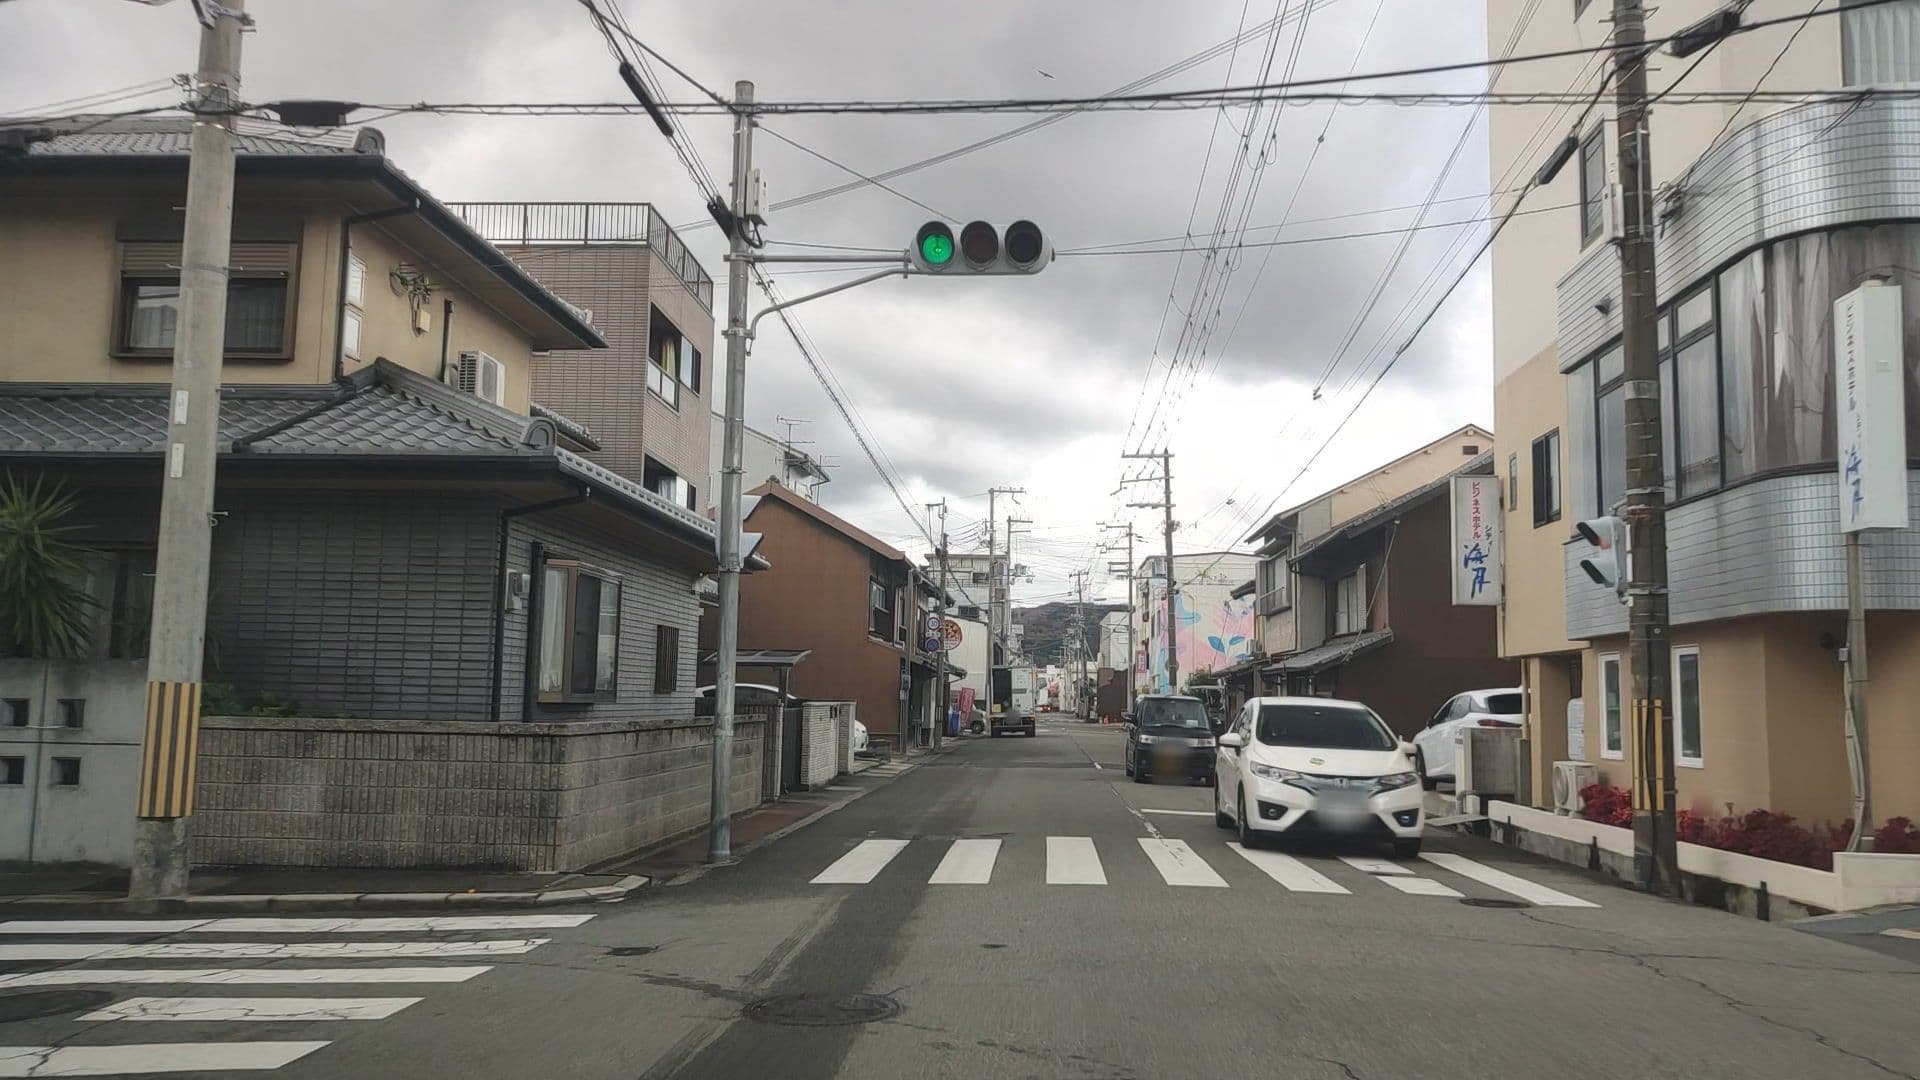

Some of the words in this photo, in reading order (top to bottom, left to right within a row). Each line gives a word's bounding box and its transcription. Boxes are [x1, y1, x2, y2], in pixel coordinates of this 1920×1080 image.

[1472, 481, 1482, 541] ビジネスホテル
